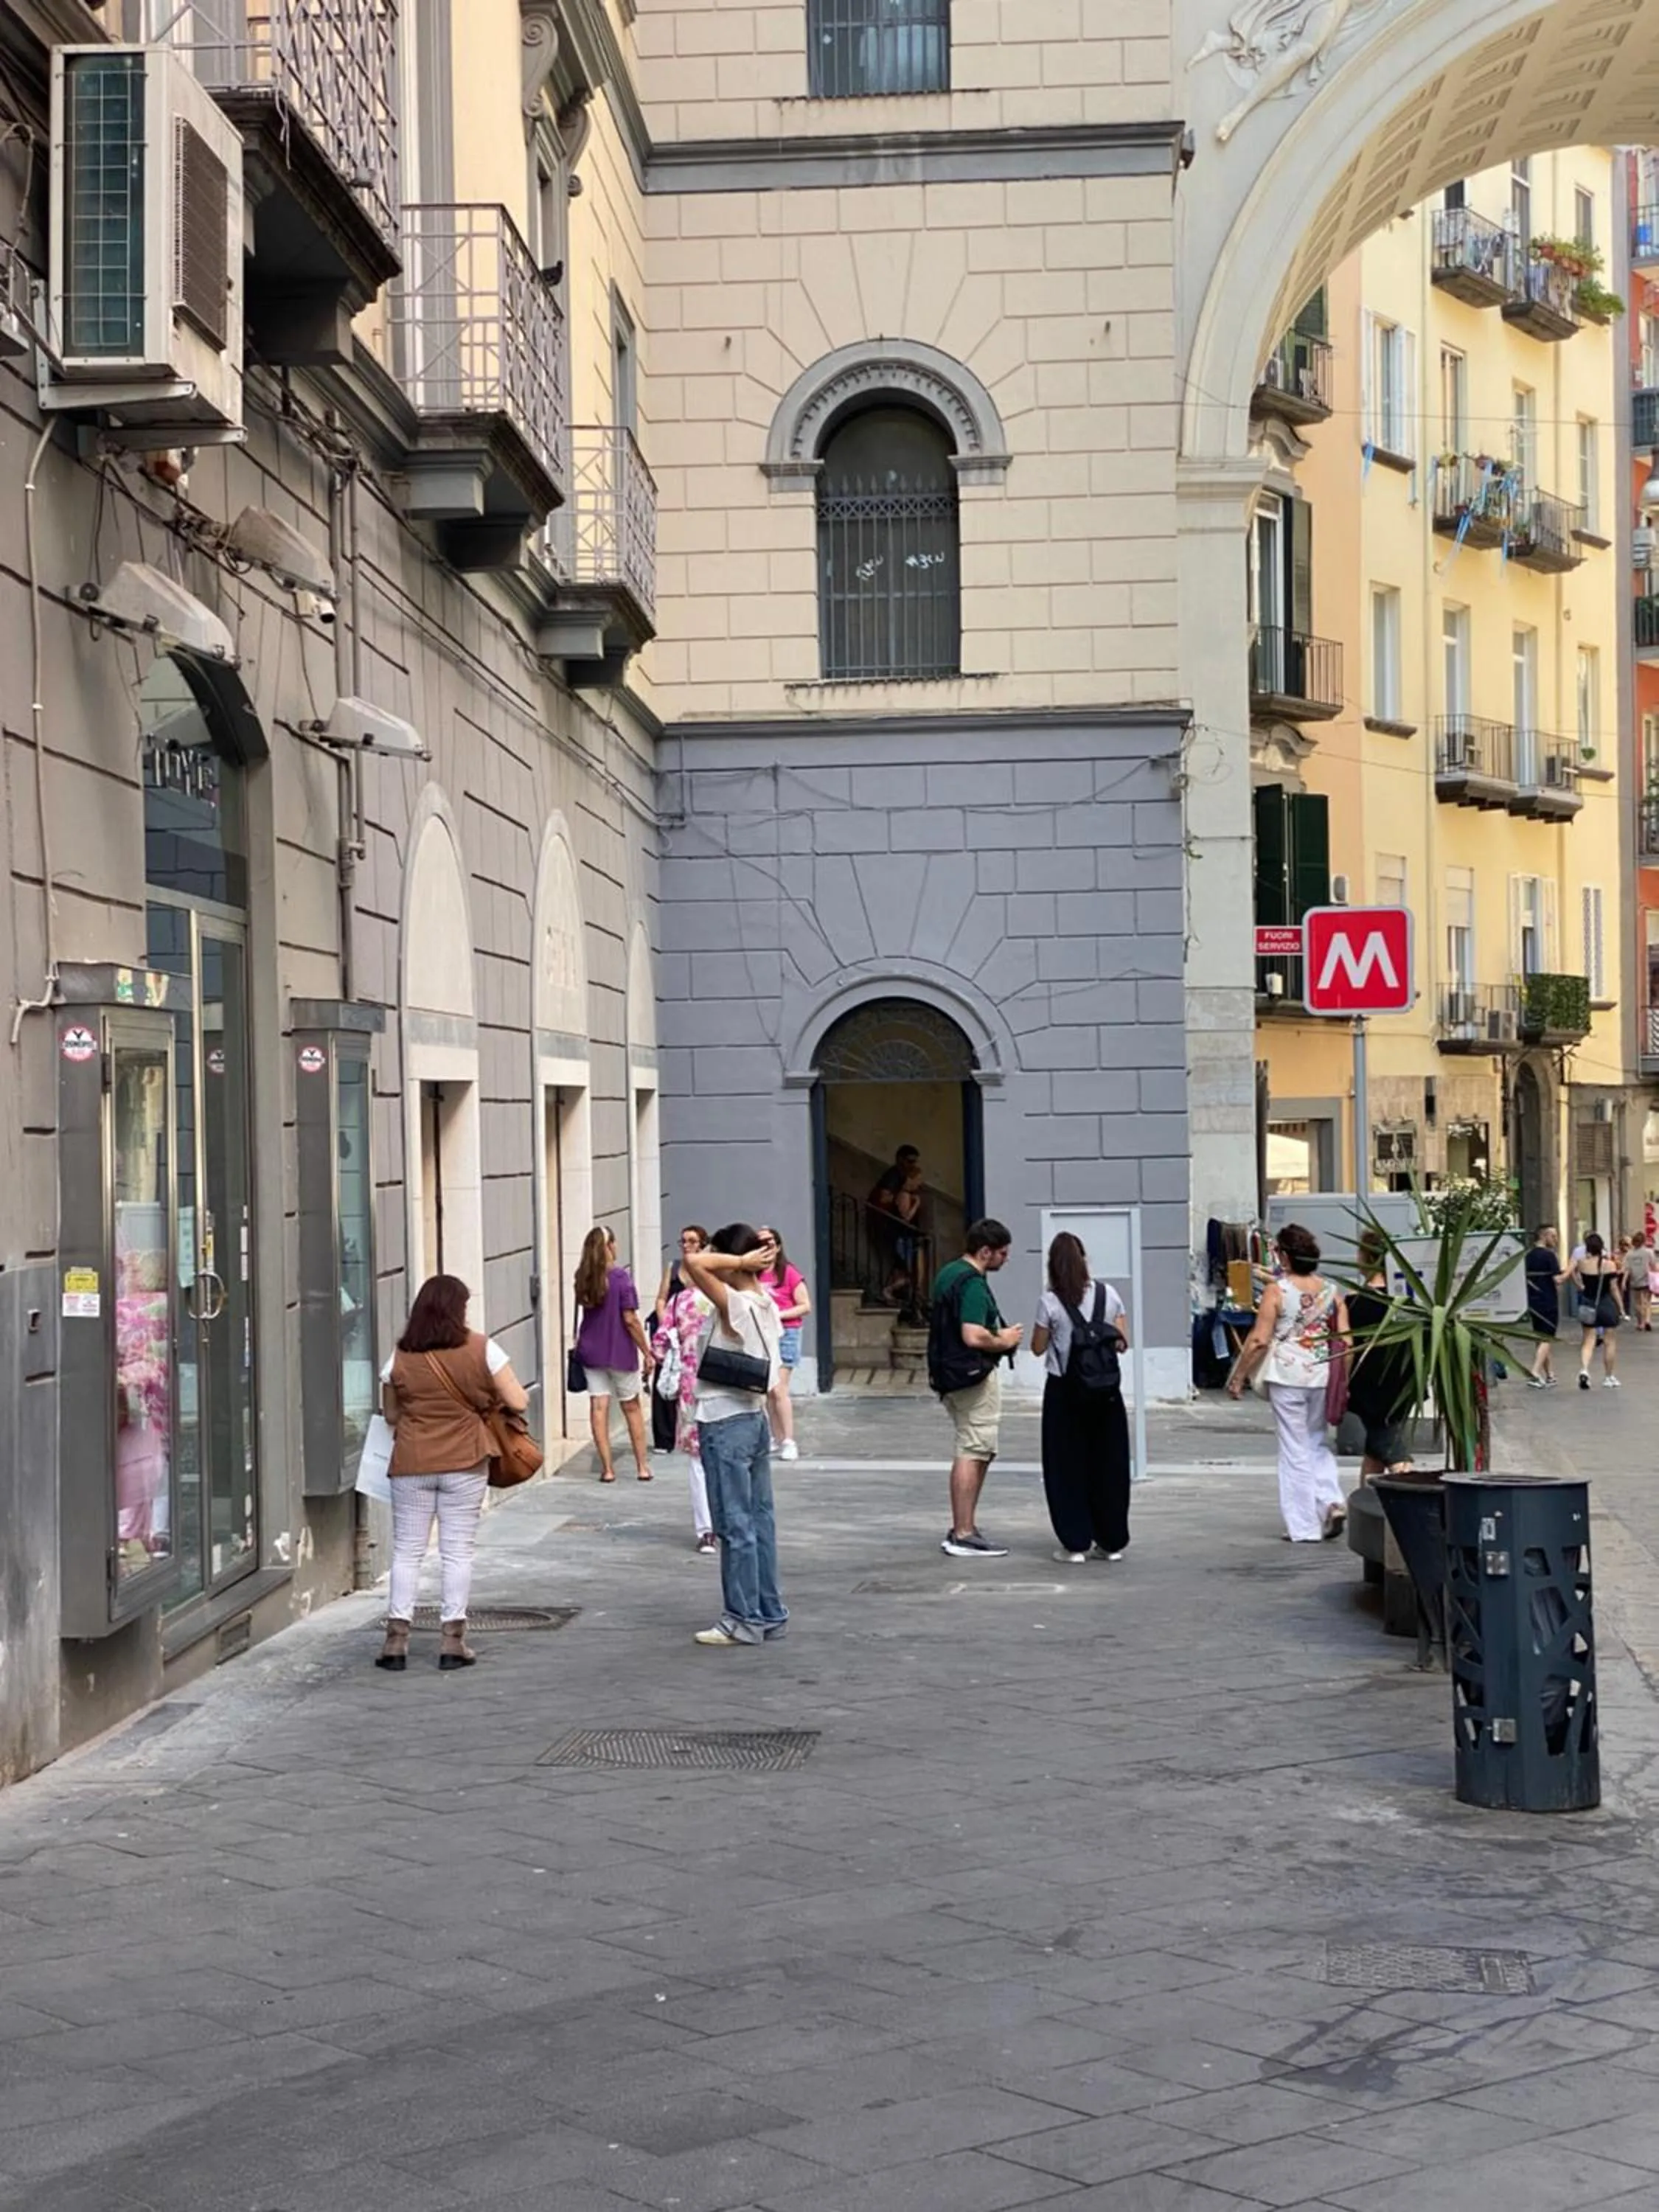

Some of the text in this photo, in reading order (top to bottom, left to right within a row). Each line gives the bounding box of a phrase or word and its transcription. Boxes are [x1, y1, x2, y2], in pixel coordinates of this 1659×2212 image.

[1264, 931, 1293, 939] FUORI
[1258, 942, 1300, 950] SERVIZIO
[1317, 931, 1399, 989] M
